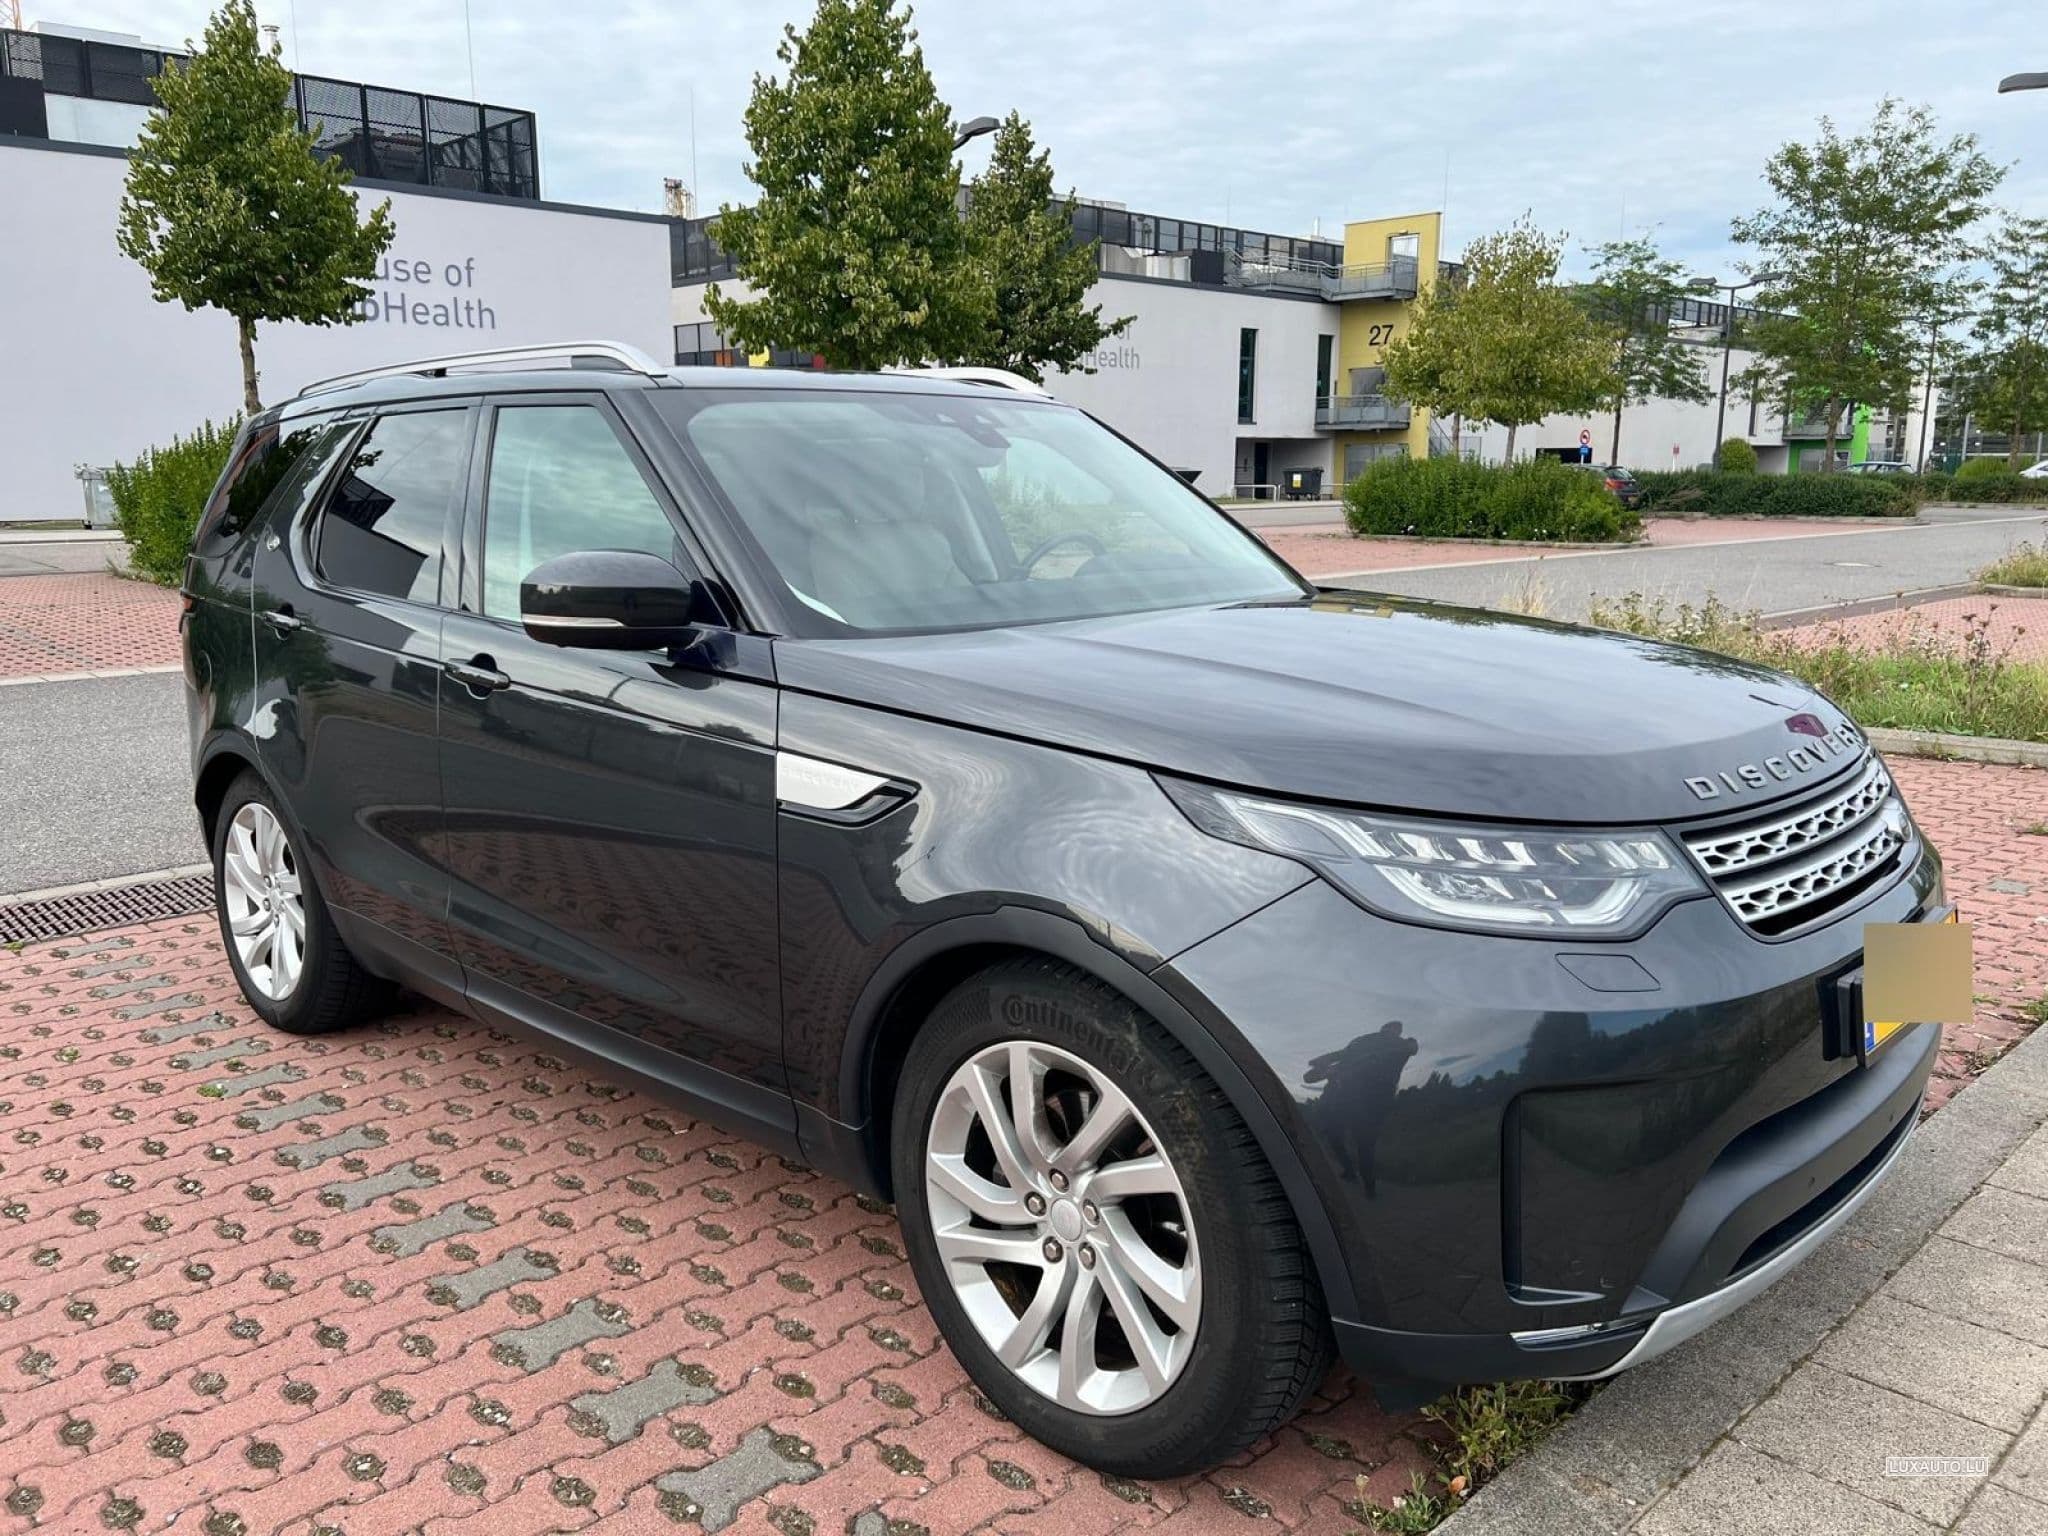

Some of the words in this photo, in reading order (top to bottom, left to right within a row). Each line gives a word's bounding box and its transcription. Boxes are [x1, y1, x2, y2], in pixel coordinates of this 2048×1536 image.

[376, 257, 432, 284] use
[444, 257, 475, 288] of
[361, 290, 496, 330] oHealth
[1369, 324, 1394, 347] 27
[1085, 345, 1140, 370] Health
[1683, 719, 1866, 800] DISCOVER
